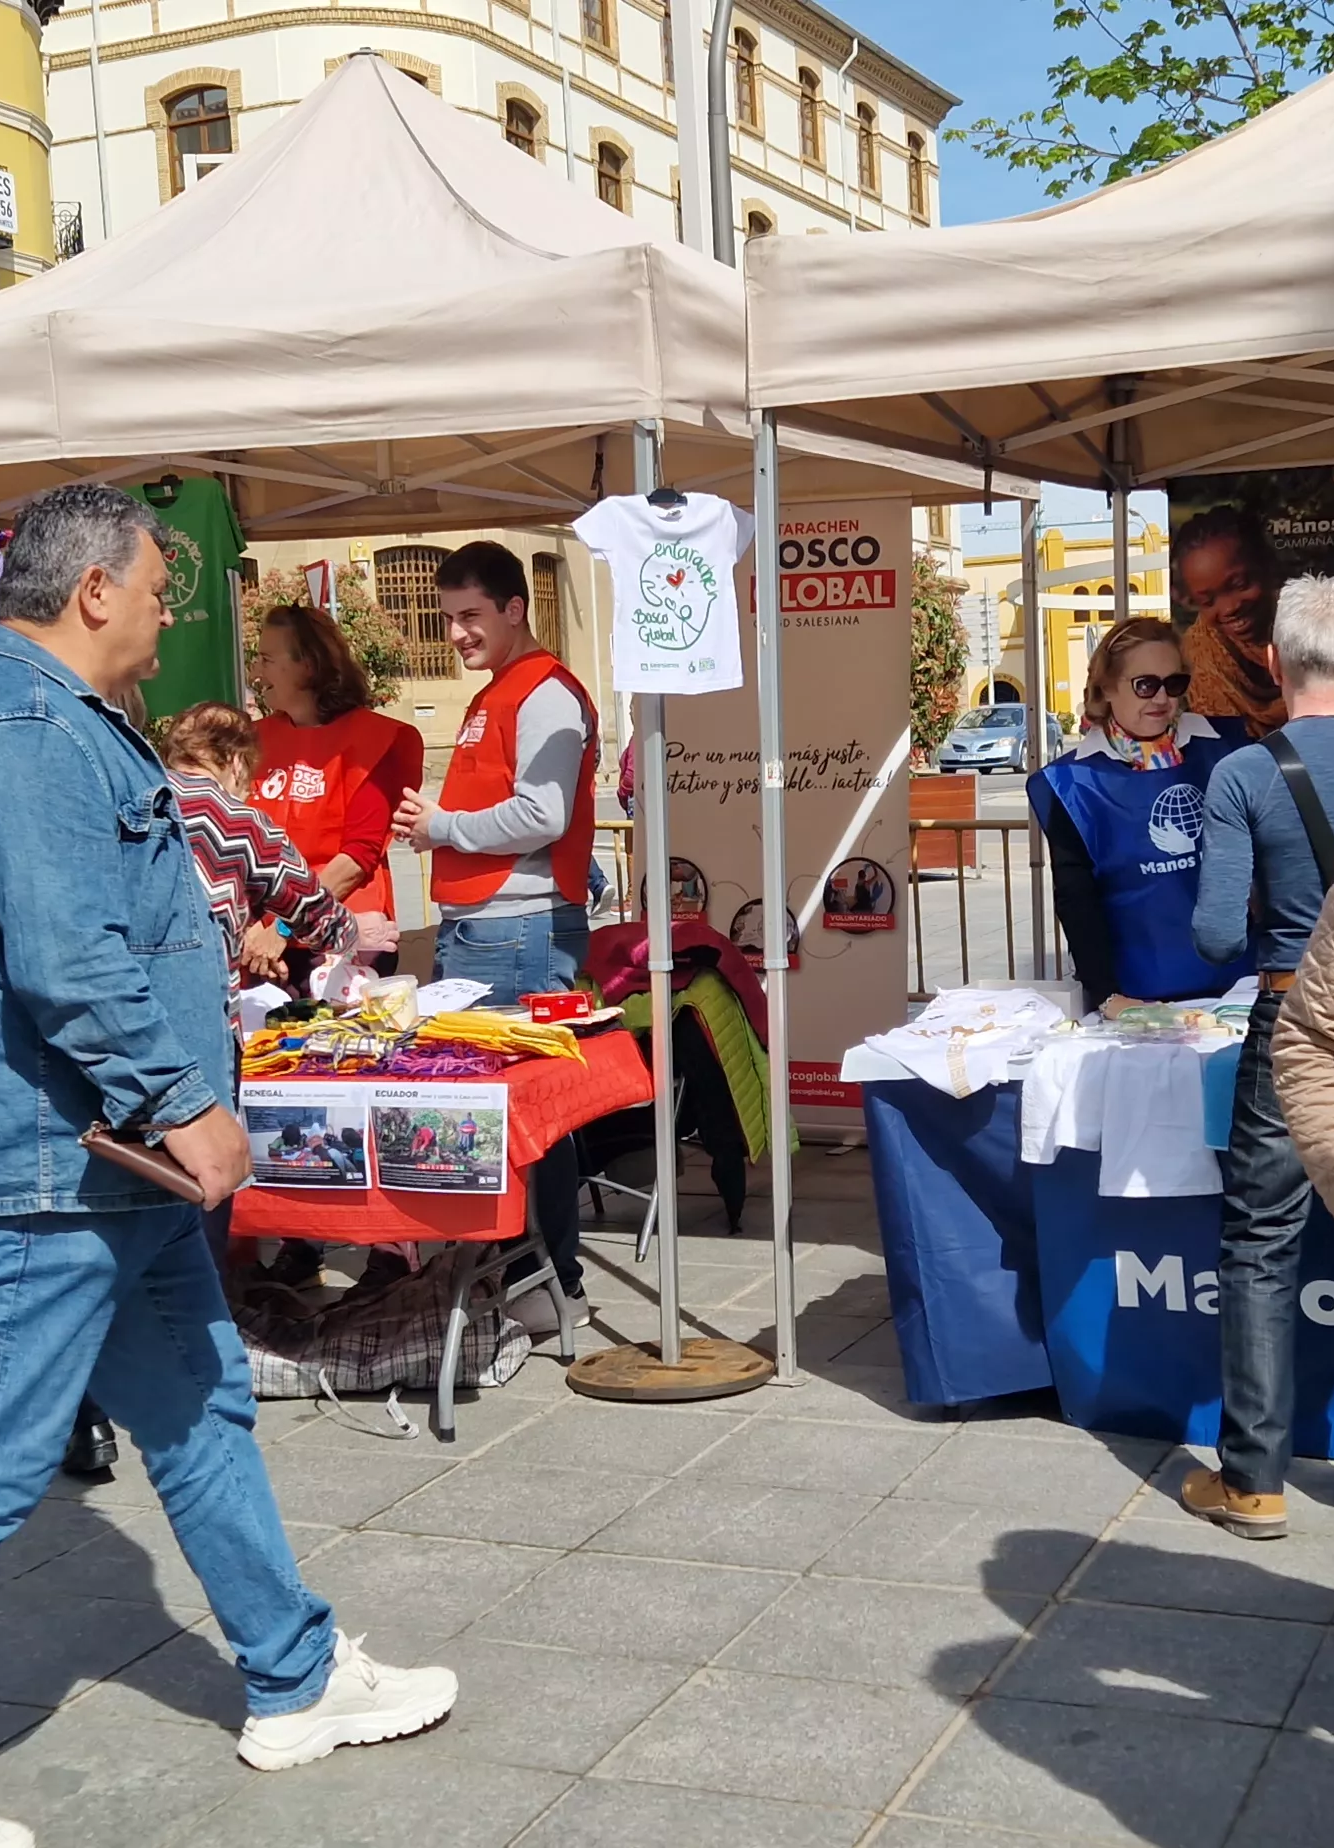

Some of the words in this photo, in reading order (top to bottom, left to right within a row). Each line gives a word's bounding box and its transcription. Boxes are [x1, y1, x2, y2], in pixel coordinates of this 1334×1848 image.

[0, 199, 13, 218] 56
[779, 519, 860, 536] TARACHEN
[754, 535, 881, 572] OSCO
[653, 537, 719, 600] entarachen
[754, 574, 891, 609] LOBAL
[631, 608, 669, 625] Bosco
[795, 615, 860, 629] SALESIANA
[638, 625, 678, 647] Global
[665, 741, 700, 763] Por
[705, 750, 725, 764] un
[788, 743, 819, 765] más
[641, 770, 719, 794] itativo
[722, 781, 734, 805] y
[736, 766, 827, 794] sosible...
[1139, 856, 1196, 875] Manos
[789, 1071, 841, 1083] scoglobal
[243, 1089, 284, 1098] SENEGAL
[375, 1089, 419, 1098] ECUADOR
[790, 1087, 845, 1098] oscoglobal.org
